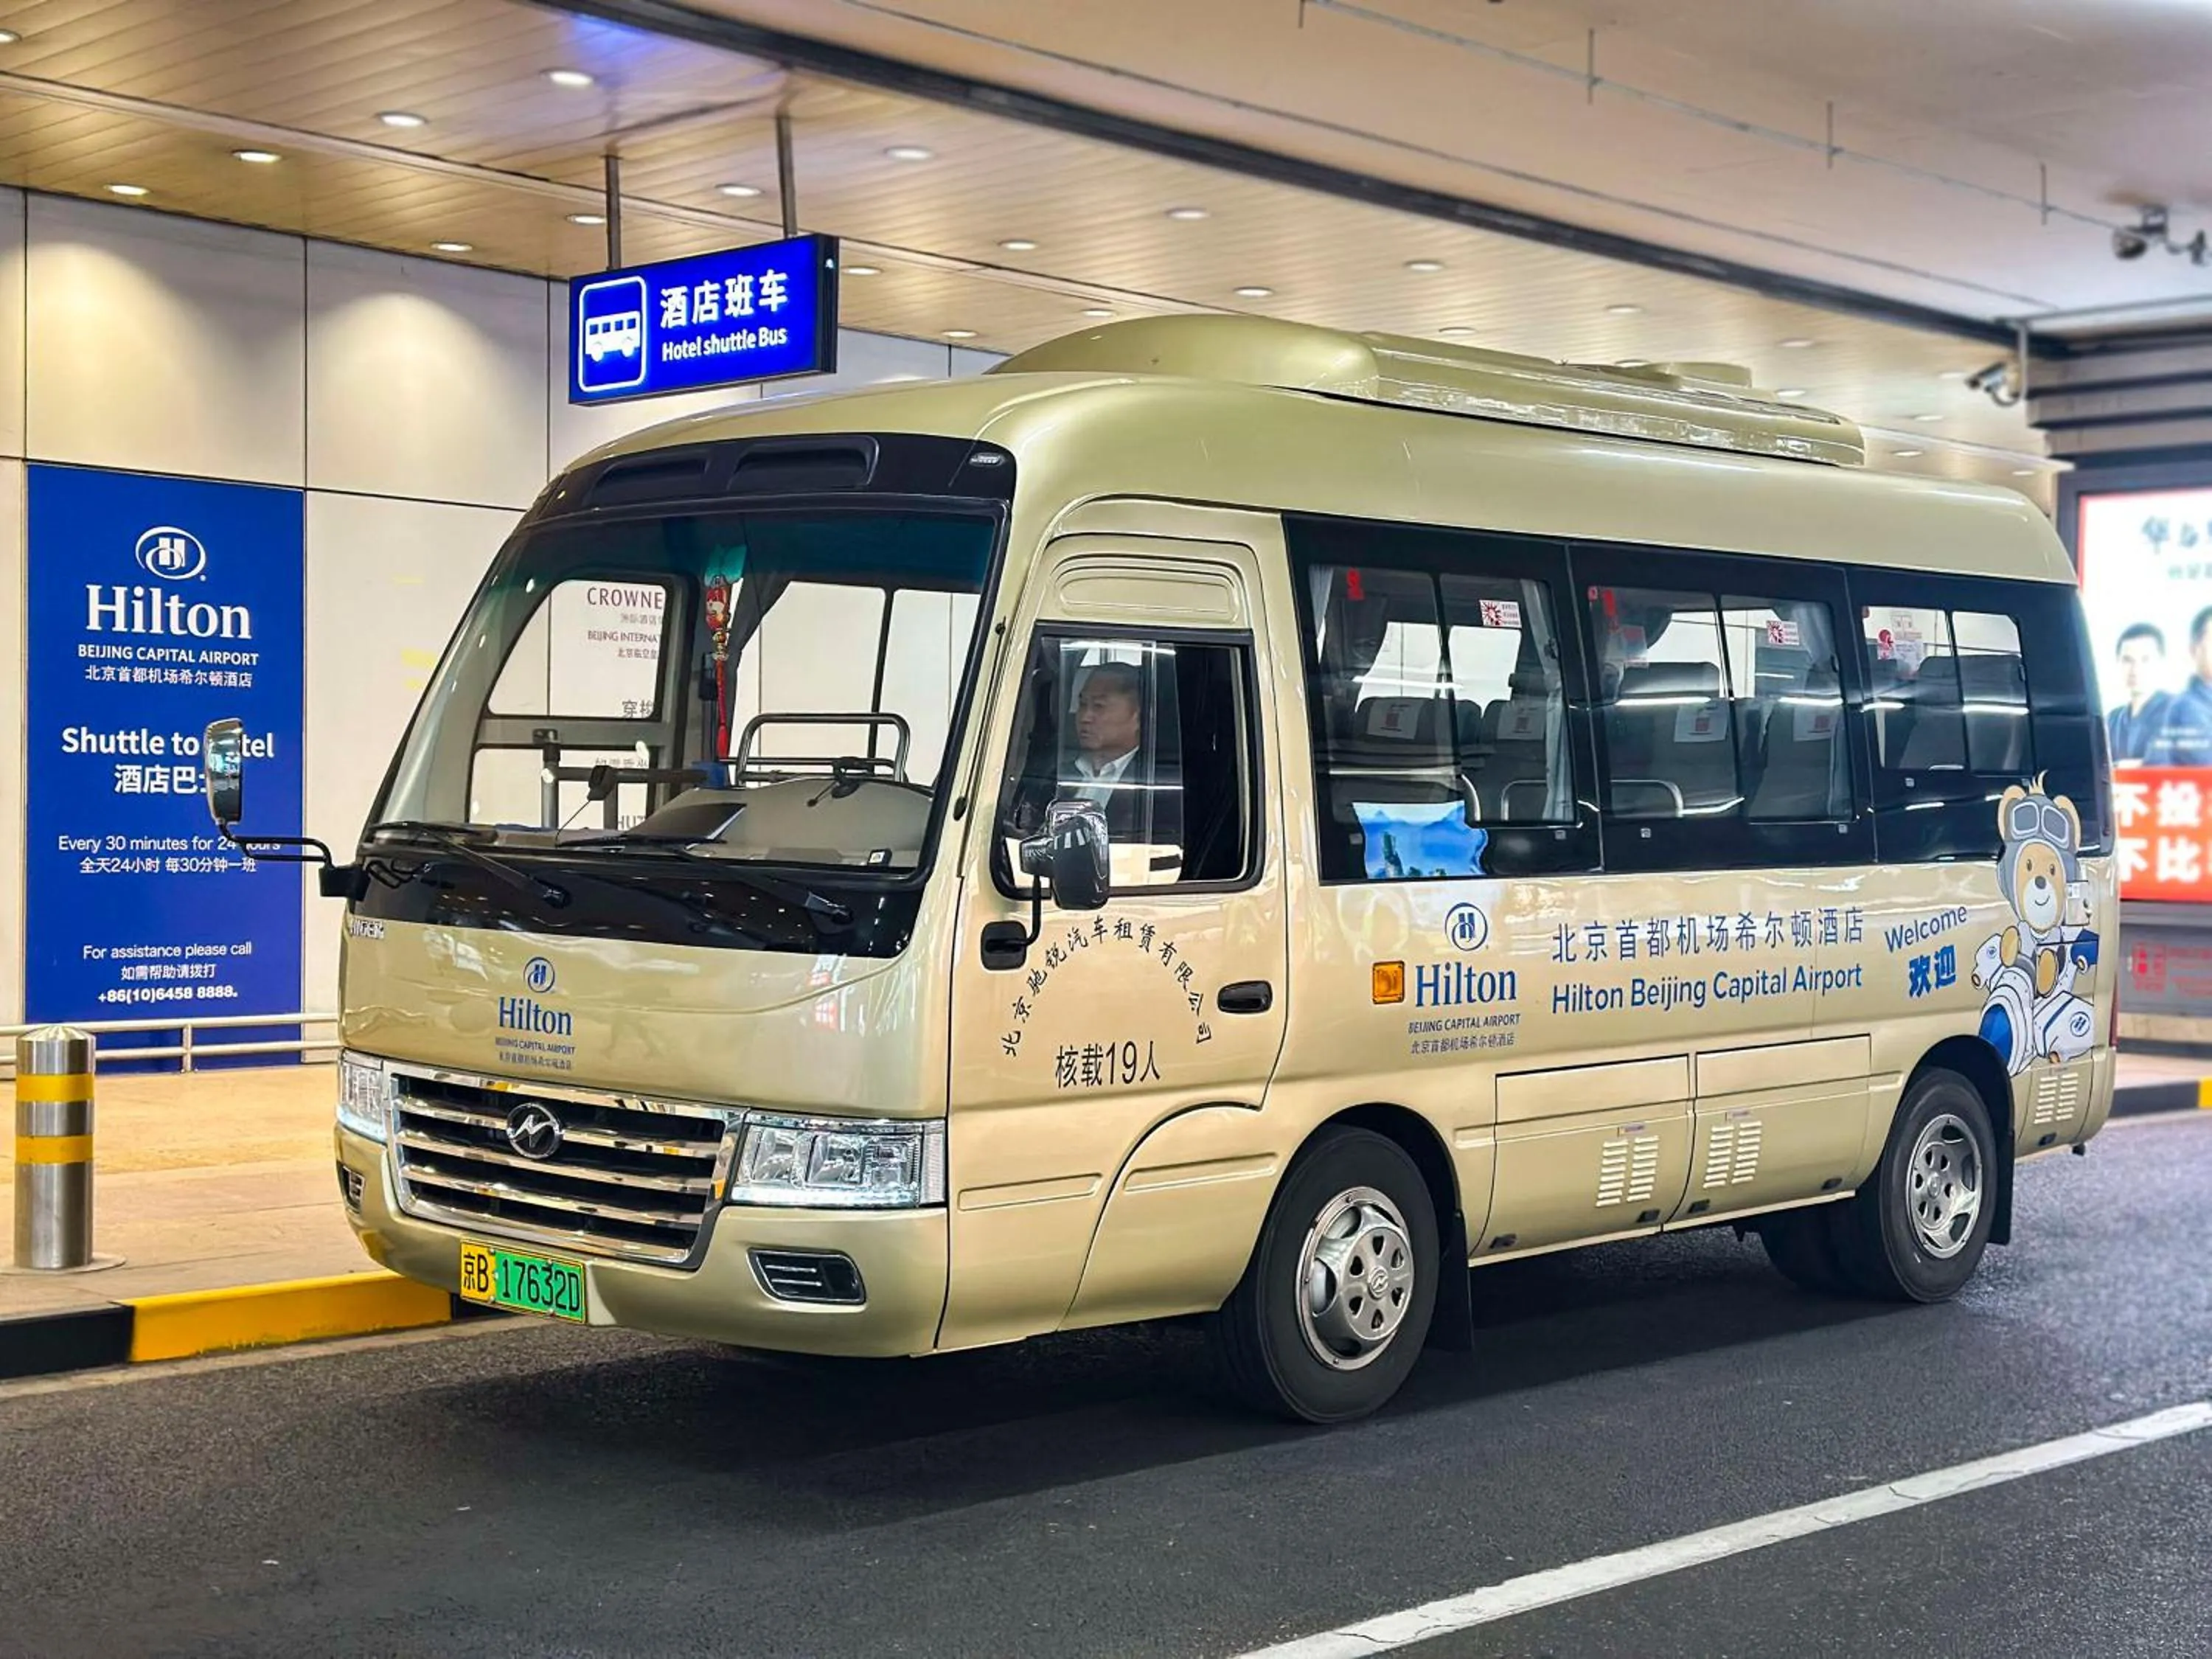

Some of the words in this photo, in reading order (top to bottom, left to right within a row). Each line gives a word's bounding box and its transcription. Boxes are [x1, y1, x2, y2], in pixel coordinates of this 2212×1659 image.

[660, 268, 788, 329] 酒店班车
[661, 336, 702, 362] Hotel
[703, 329, 756, 355] shuttle
[759, 327, 787, 347] Bus
[86, 584, 252, 639] Hilton
[587, 588, 663, 610] CROWNE
[588, 630, 619, 641] BEIJING
[620, 632, 661, 643] INTERNA
[78, 644, 133, 660] BEIJING
[136, 647, 195, 663] CAPITAL
[198, 650, 260, 666] AIRPORT
[85, 664, 252, 688] 北京首都机场希尔顿酒店
[62, 727, 164, 755] Shuttle
[171, 732, 200, 757] to
[241, 732, 275, 758] tel
[114, 764, 206, 794] 酒店巴
[59, 835, 101, 854] Every
[105, 835, 125, 850] 30
[130, 835, 188, 850] minutes
[191, 835, 213, 850] for
[218, 835, 236, 850] 24
[2117, 835, 2212, 883] 不比
[80, 858, 160, 874] 全天24小时
[164, 856, 257, 873] 每30分钟一班
[1552, 906, 1863, 963] 北京首都机场希尔顿酒店
[1884, 906, 1967, 953] Welcome
[83, 945, 107, 959] For
[111, 944, 181, 959] assistance
[185, 943, 227, 959] please
[230, 942, 251, 956] call
[1415, 961, 1517, 1007] Hilton
[1552, 982, 1623, 1014] Hilton
[1631, 974, 1706, 1011] Beijing
[1713, 967, 1787, 1004] Capital
[1792, 962, 1862, 995] Airport
[1907, 946, 1956, 998] 欢迎
[98, 987, 192, 1004] +86(10)6458
[498, 996, 572, 1036] Hilton
[1408, 1020, 1443, 1034] BEIJING
[1444, 1017, 1481, 1030] CAPITAL
[1483, 1013, 1521, 1027] AIRPORT
[1055, 1040, 1160, 1088] 核载19人
